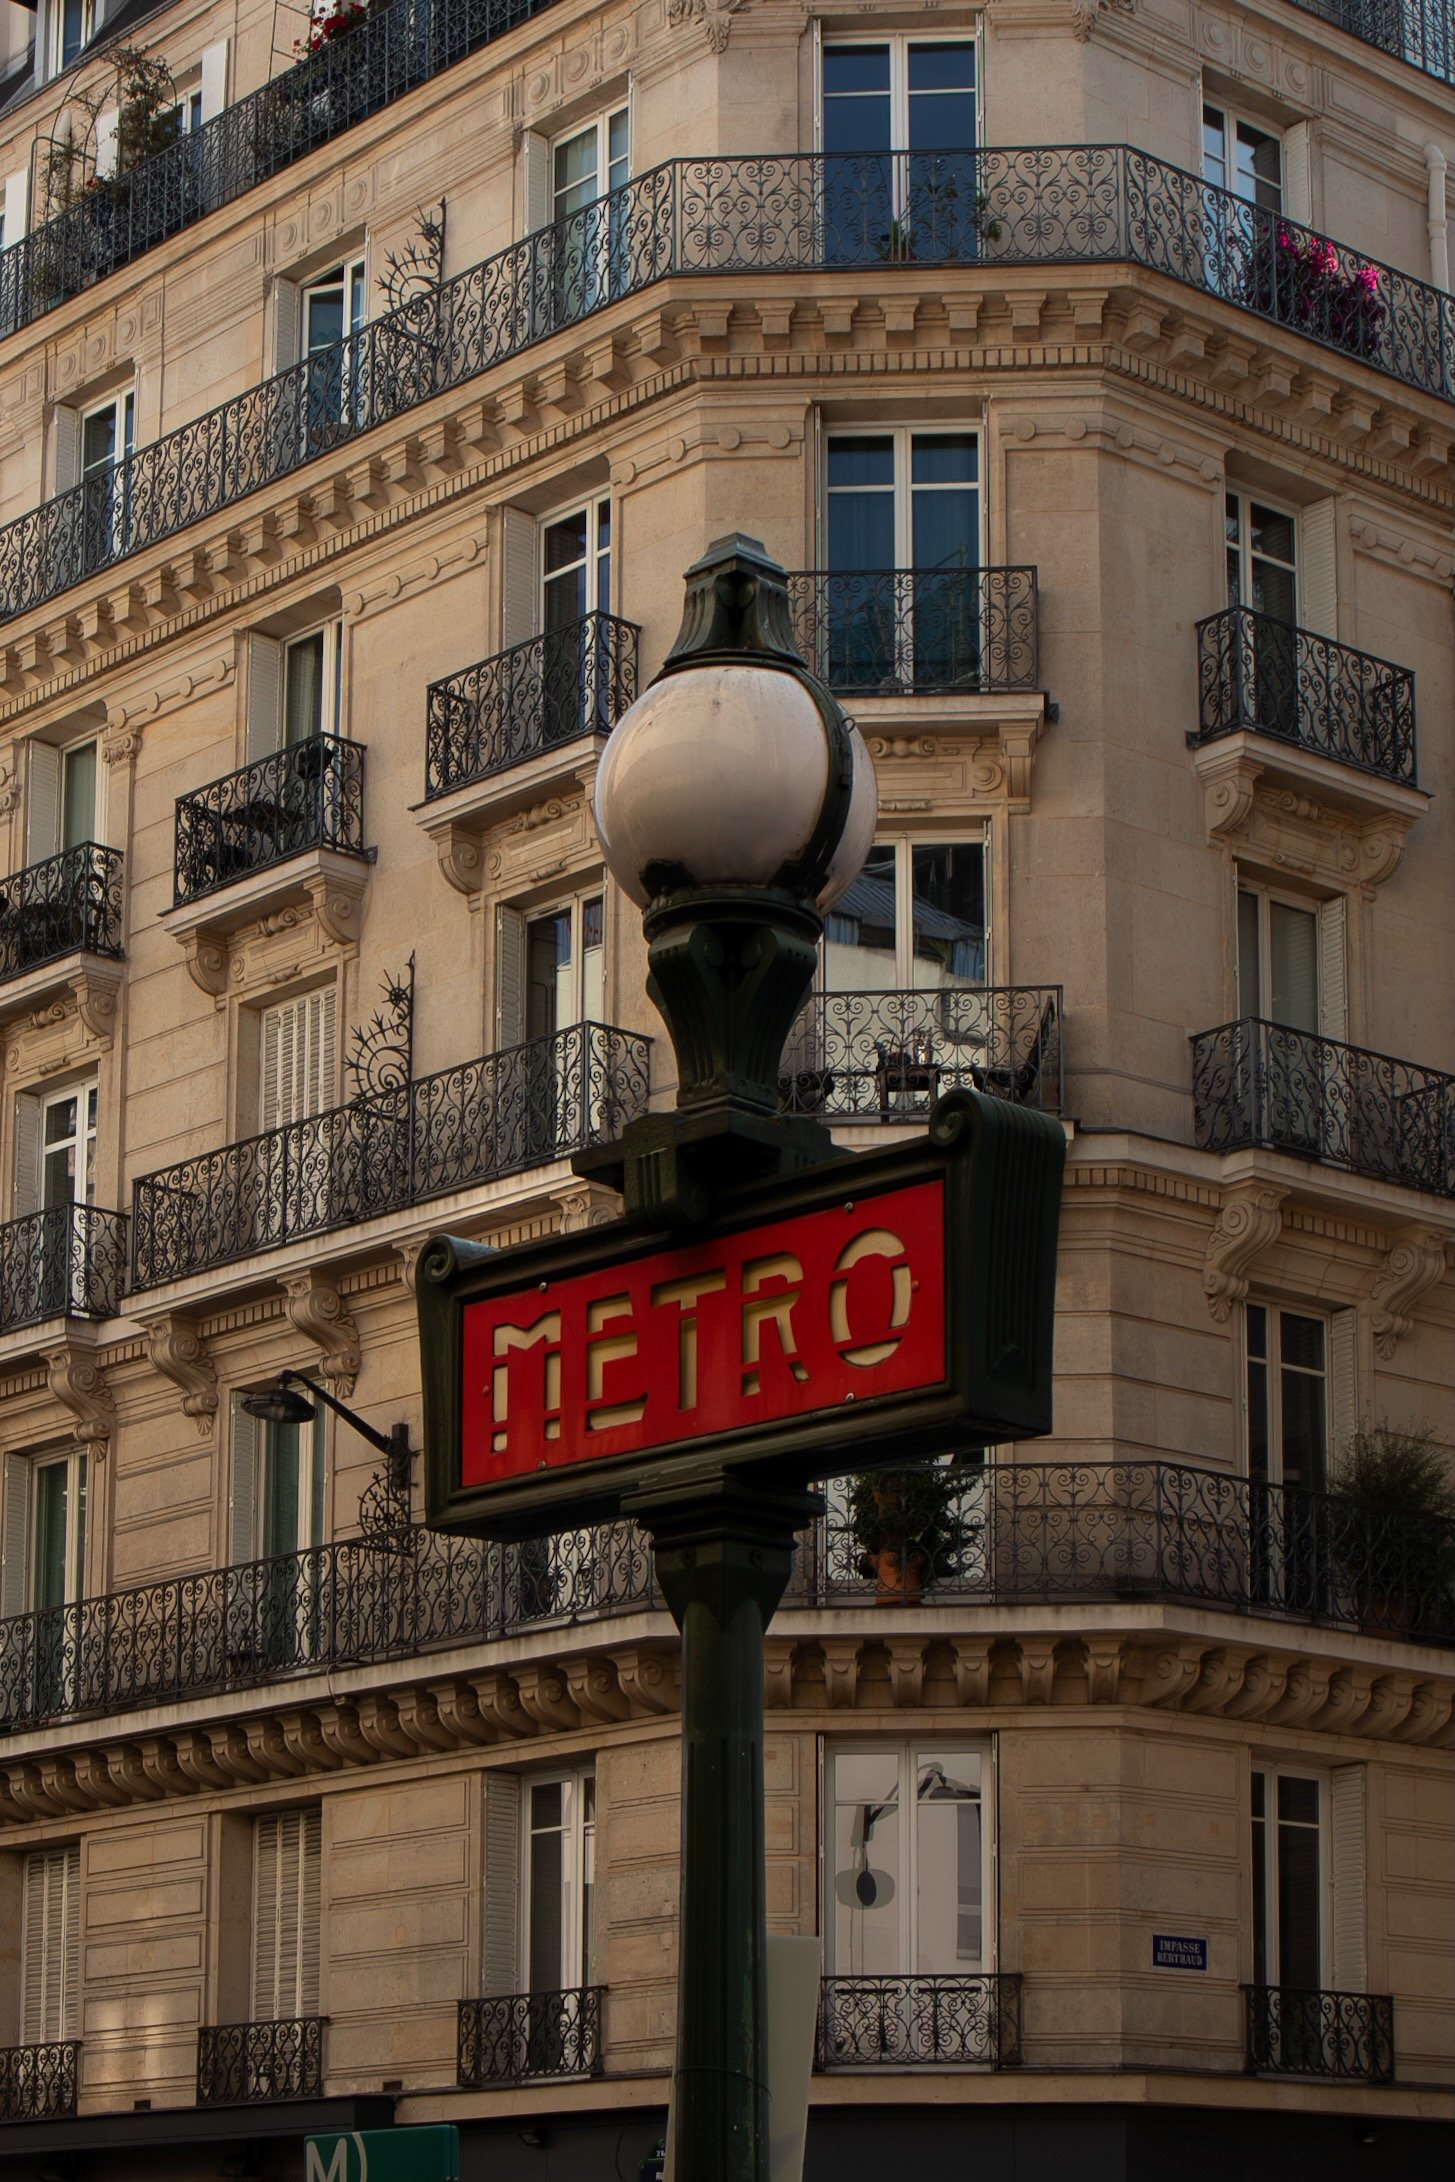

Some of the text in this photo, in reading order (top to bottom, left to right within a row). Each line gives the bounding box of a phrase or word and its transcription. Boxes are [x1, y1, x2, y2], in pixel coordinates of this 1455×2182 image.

[491, 1227, 913, 1453] METRO
[1160, 1940, 1201, 1953] IMPASSE
[1157, 1952, 1203, 1966] BERTHAUD
